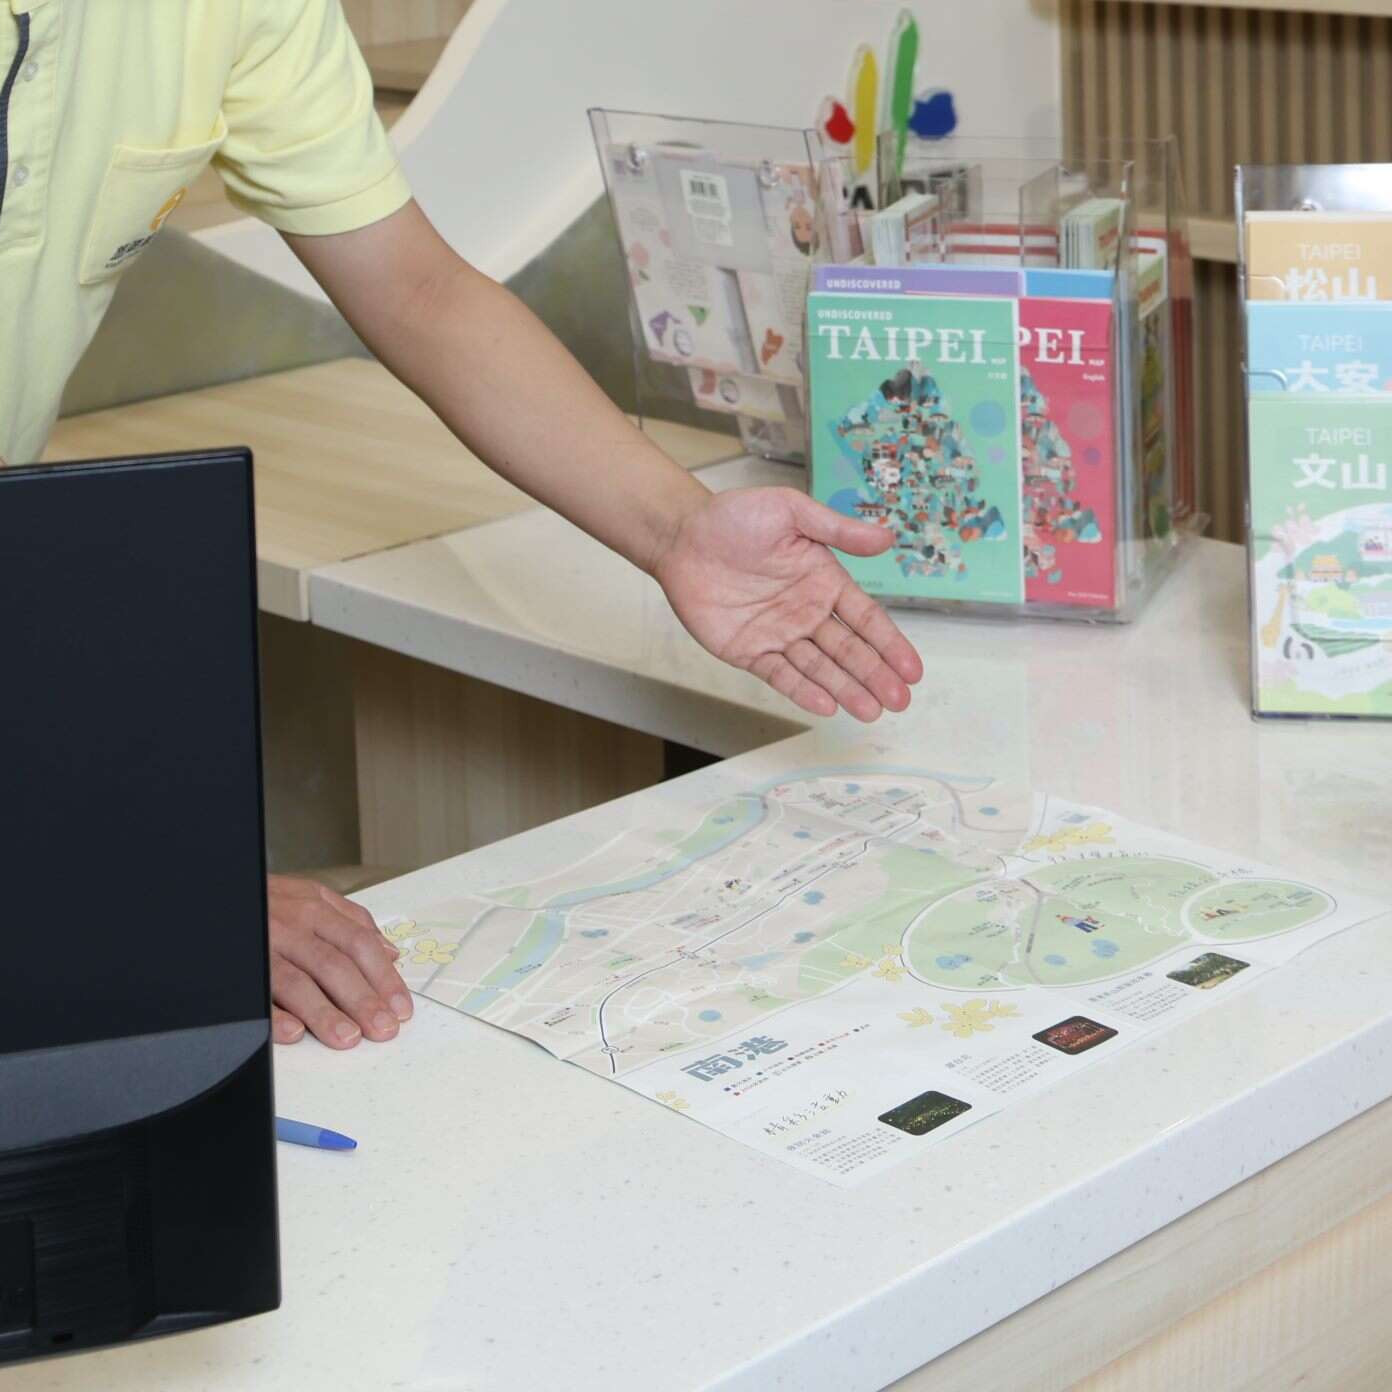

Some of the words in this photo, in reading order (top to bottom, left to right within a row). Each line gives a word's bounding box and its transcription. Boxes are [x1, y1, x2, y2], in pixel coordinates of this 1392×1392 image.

[1298, 243, 1361, 260] TAIPEI
[826, 278, 902, 290] UNDISCOVERED
[817, 309, 893, 321] UNDISCOVERED
[818, 324, 987, 365] TAIPEI
[1297, 334, 1363, 353] TAIPEI
[1286, 359, 1378, 393] 大安
[1306, 427, 1372, 446] TAIPEI
[1292, 452, 1387, 490] 文山
[679, 1034, 789, 1083] 南港
